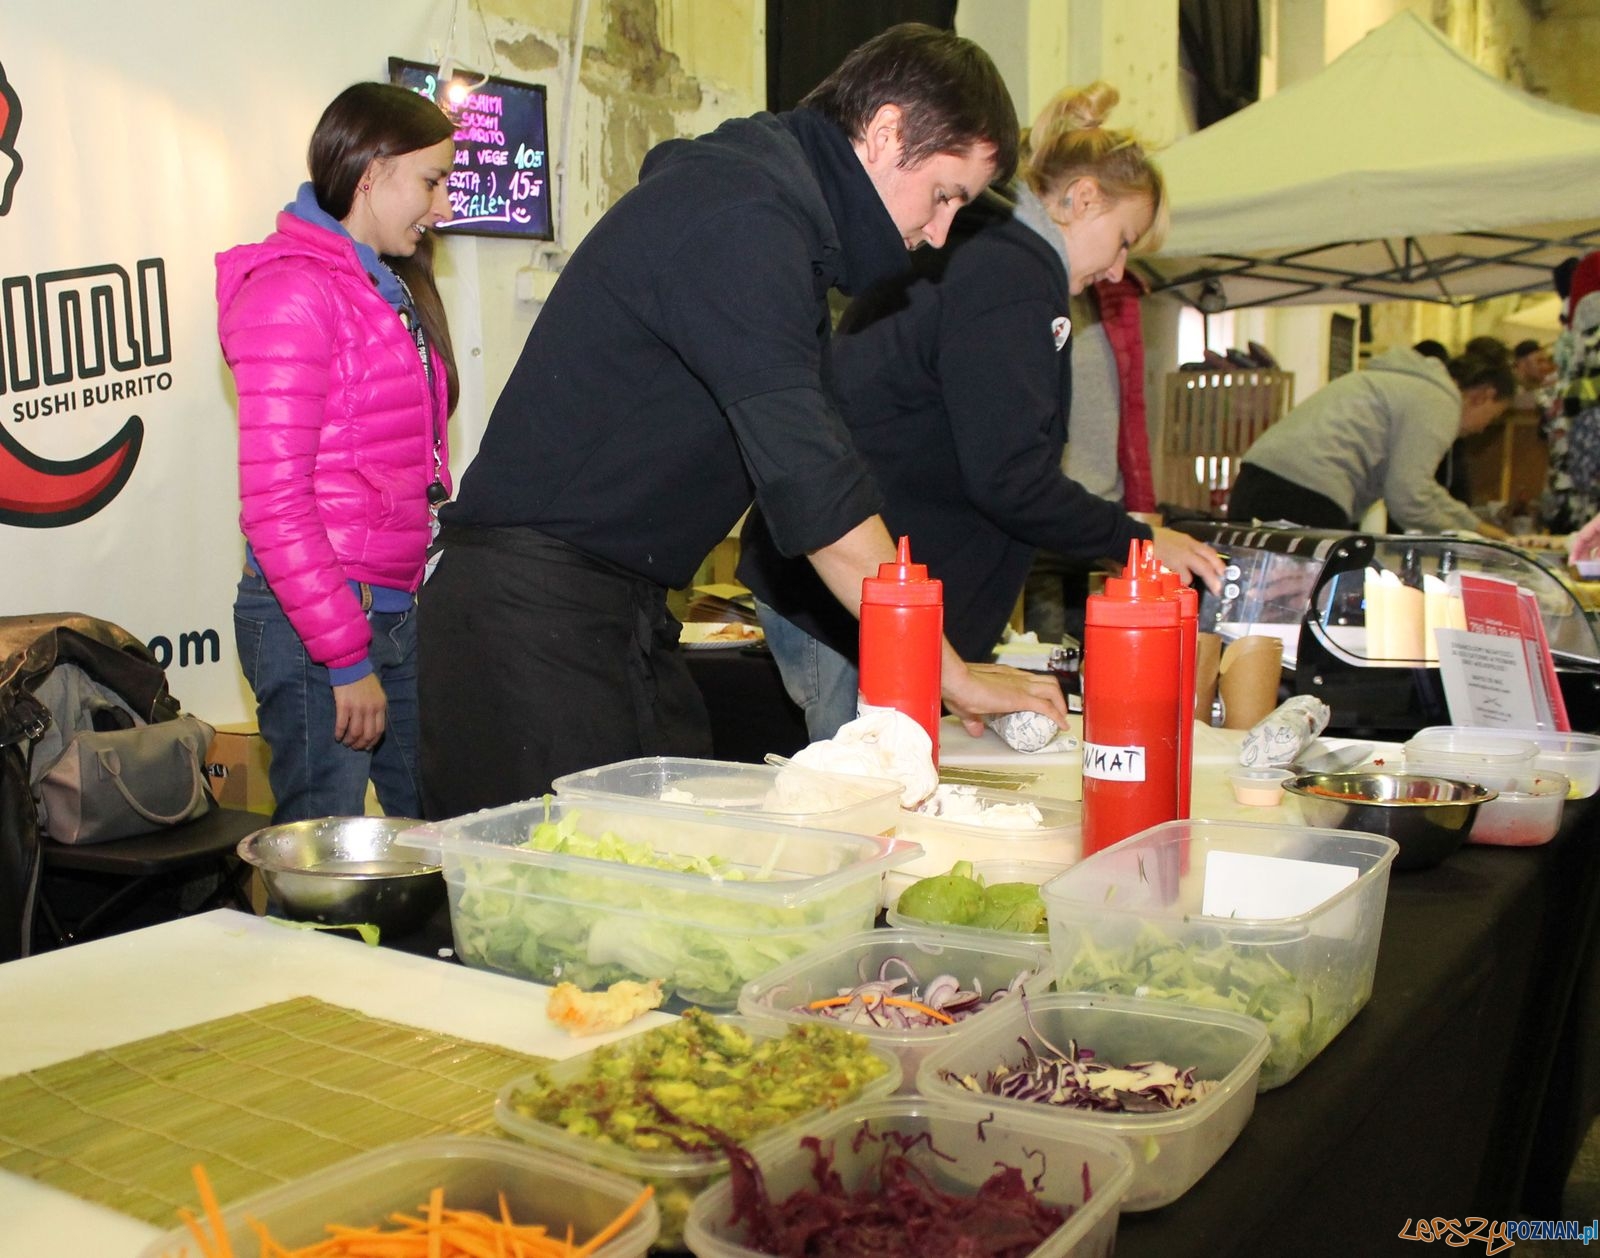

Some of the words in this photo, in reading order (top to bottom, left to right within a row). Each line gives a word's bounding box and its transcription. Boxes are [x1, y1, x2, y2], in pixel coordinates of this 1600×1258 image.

[477, 149, 509, 166] VEGE
[13, 391, 77, 423] SUSHI
[83, 372, 173, 408] BURRITO
